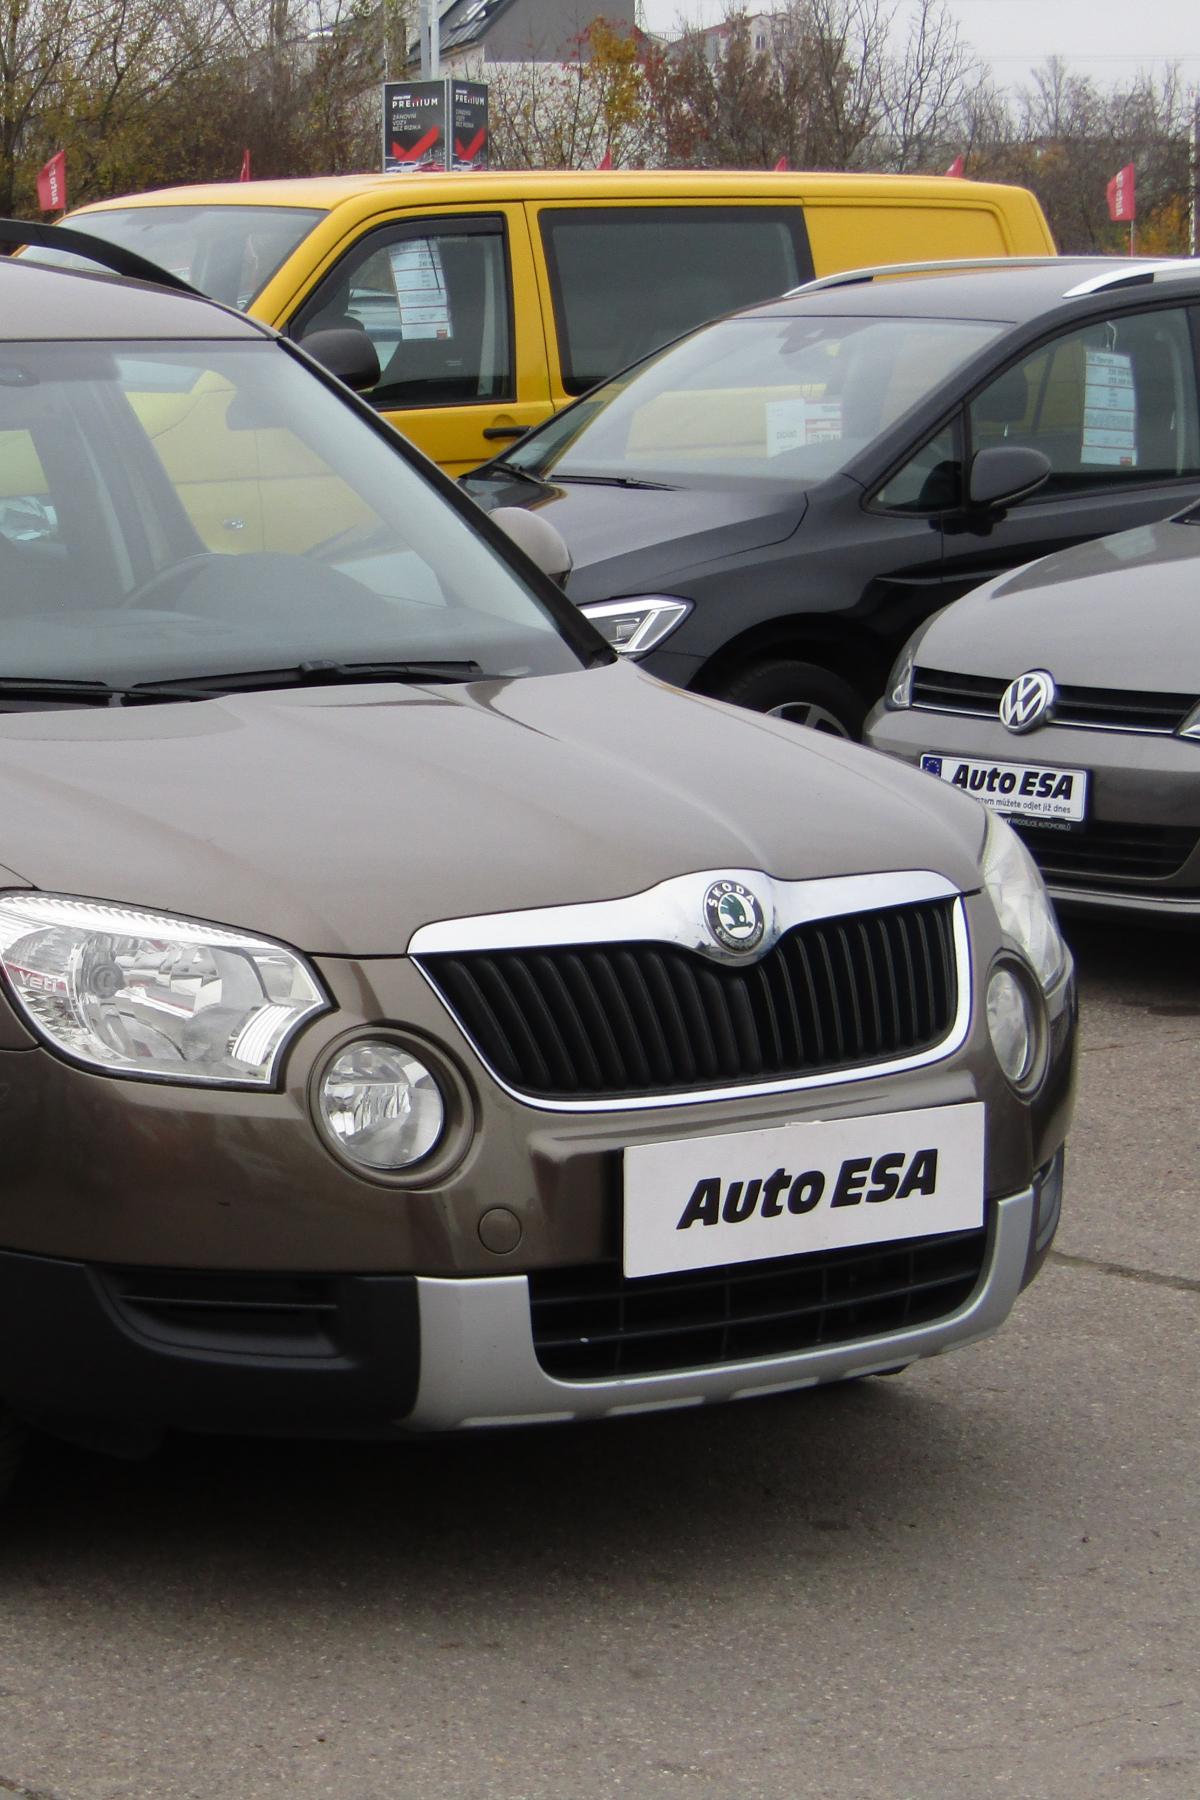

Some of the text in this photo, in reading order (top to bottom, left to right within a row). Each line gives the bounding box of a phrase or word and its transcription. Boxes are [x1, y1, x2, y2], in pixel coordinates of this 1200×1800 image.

[392, 98, 438, 109] PREMIUM
[951, 764, 1074, 800] Auto ESA
[1053, 805, 1071, 814] dnes
[676, 1148, 939, 1230] Auto ESA
